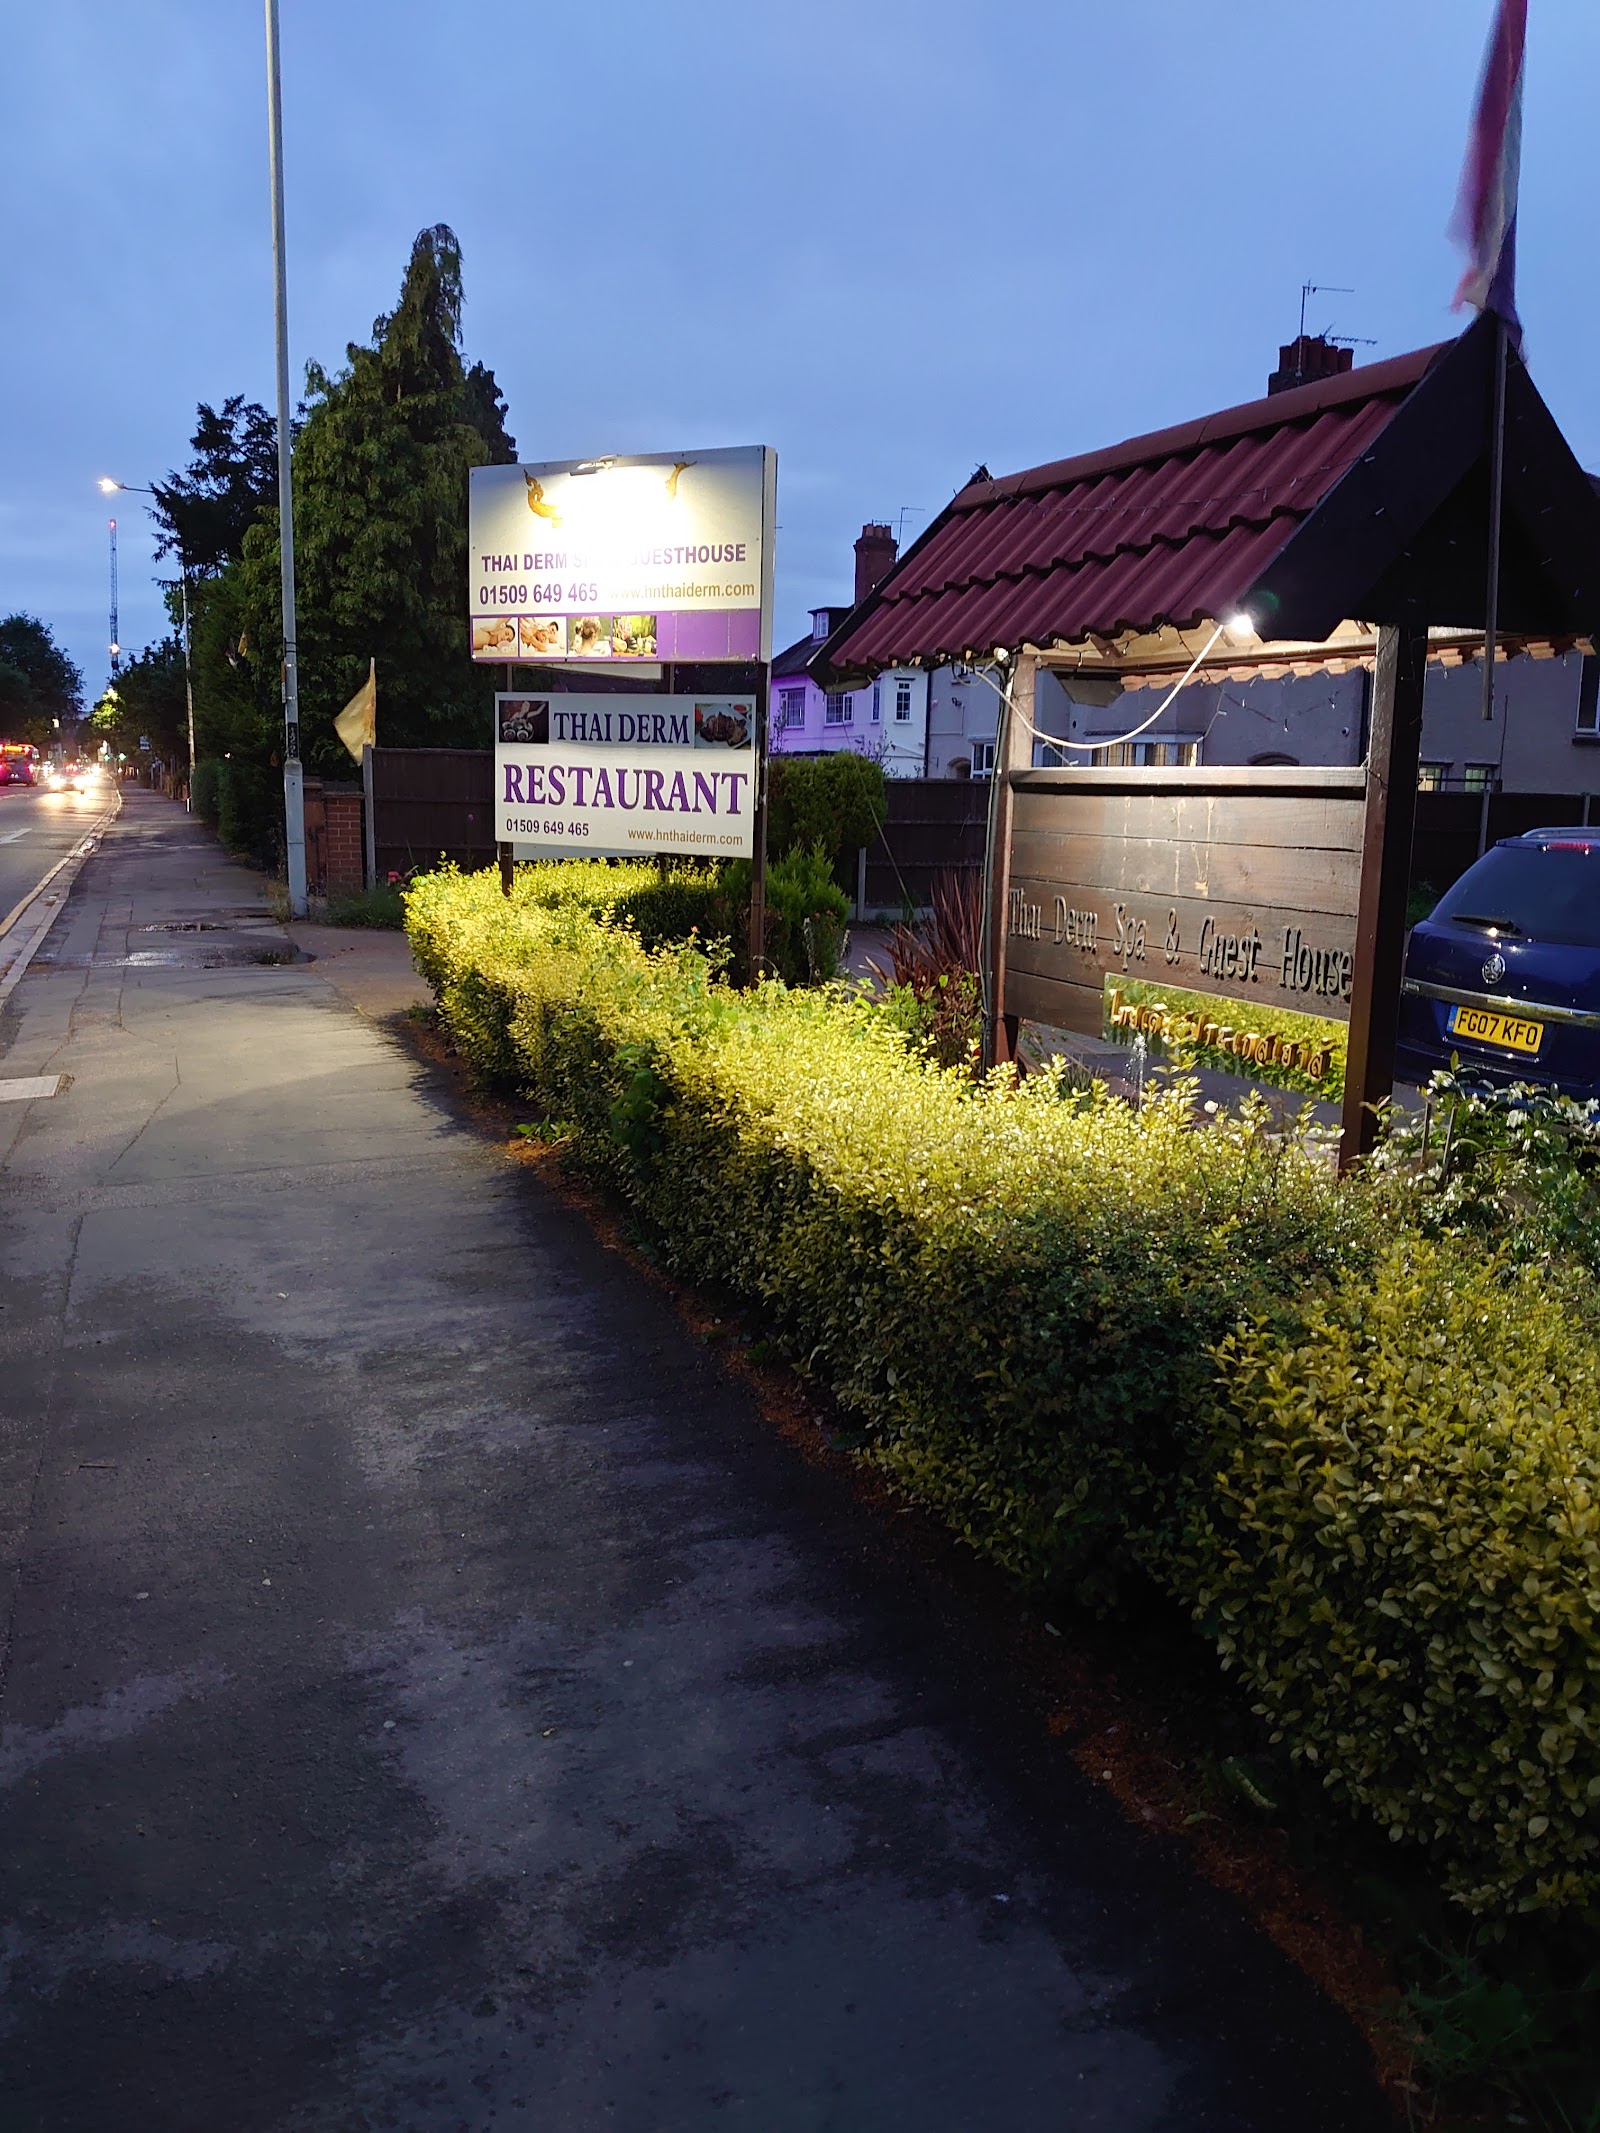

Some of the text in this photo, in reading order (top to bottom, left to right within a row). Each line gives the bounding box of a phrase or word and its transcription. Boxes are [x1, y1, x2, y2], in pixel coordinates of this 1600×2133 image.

[481, 554, 518, 573] THAI
[523, 551, 567, 571] DERM
[479, 581, 755, 605] 01509 649 465 www.hnthaiderm.com
[553, 712, 690, 745] THAI DERM
[503, 763, 748, 815] RESTAURANT
[506, 818, 743, 846] 01509 649 465 www.hnthaiderm.com
[1009, 887, 1354, 1002] Thai Derm Spa & Guest House
[1457, 1010, 1538, 1046] FG07 KFO
